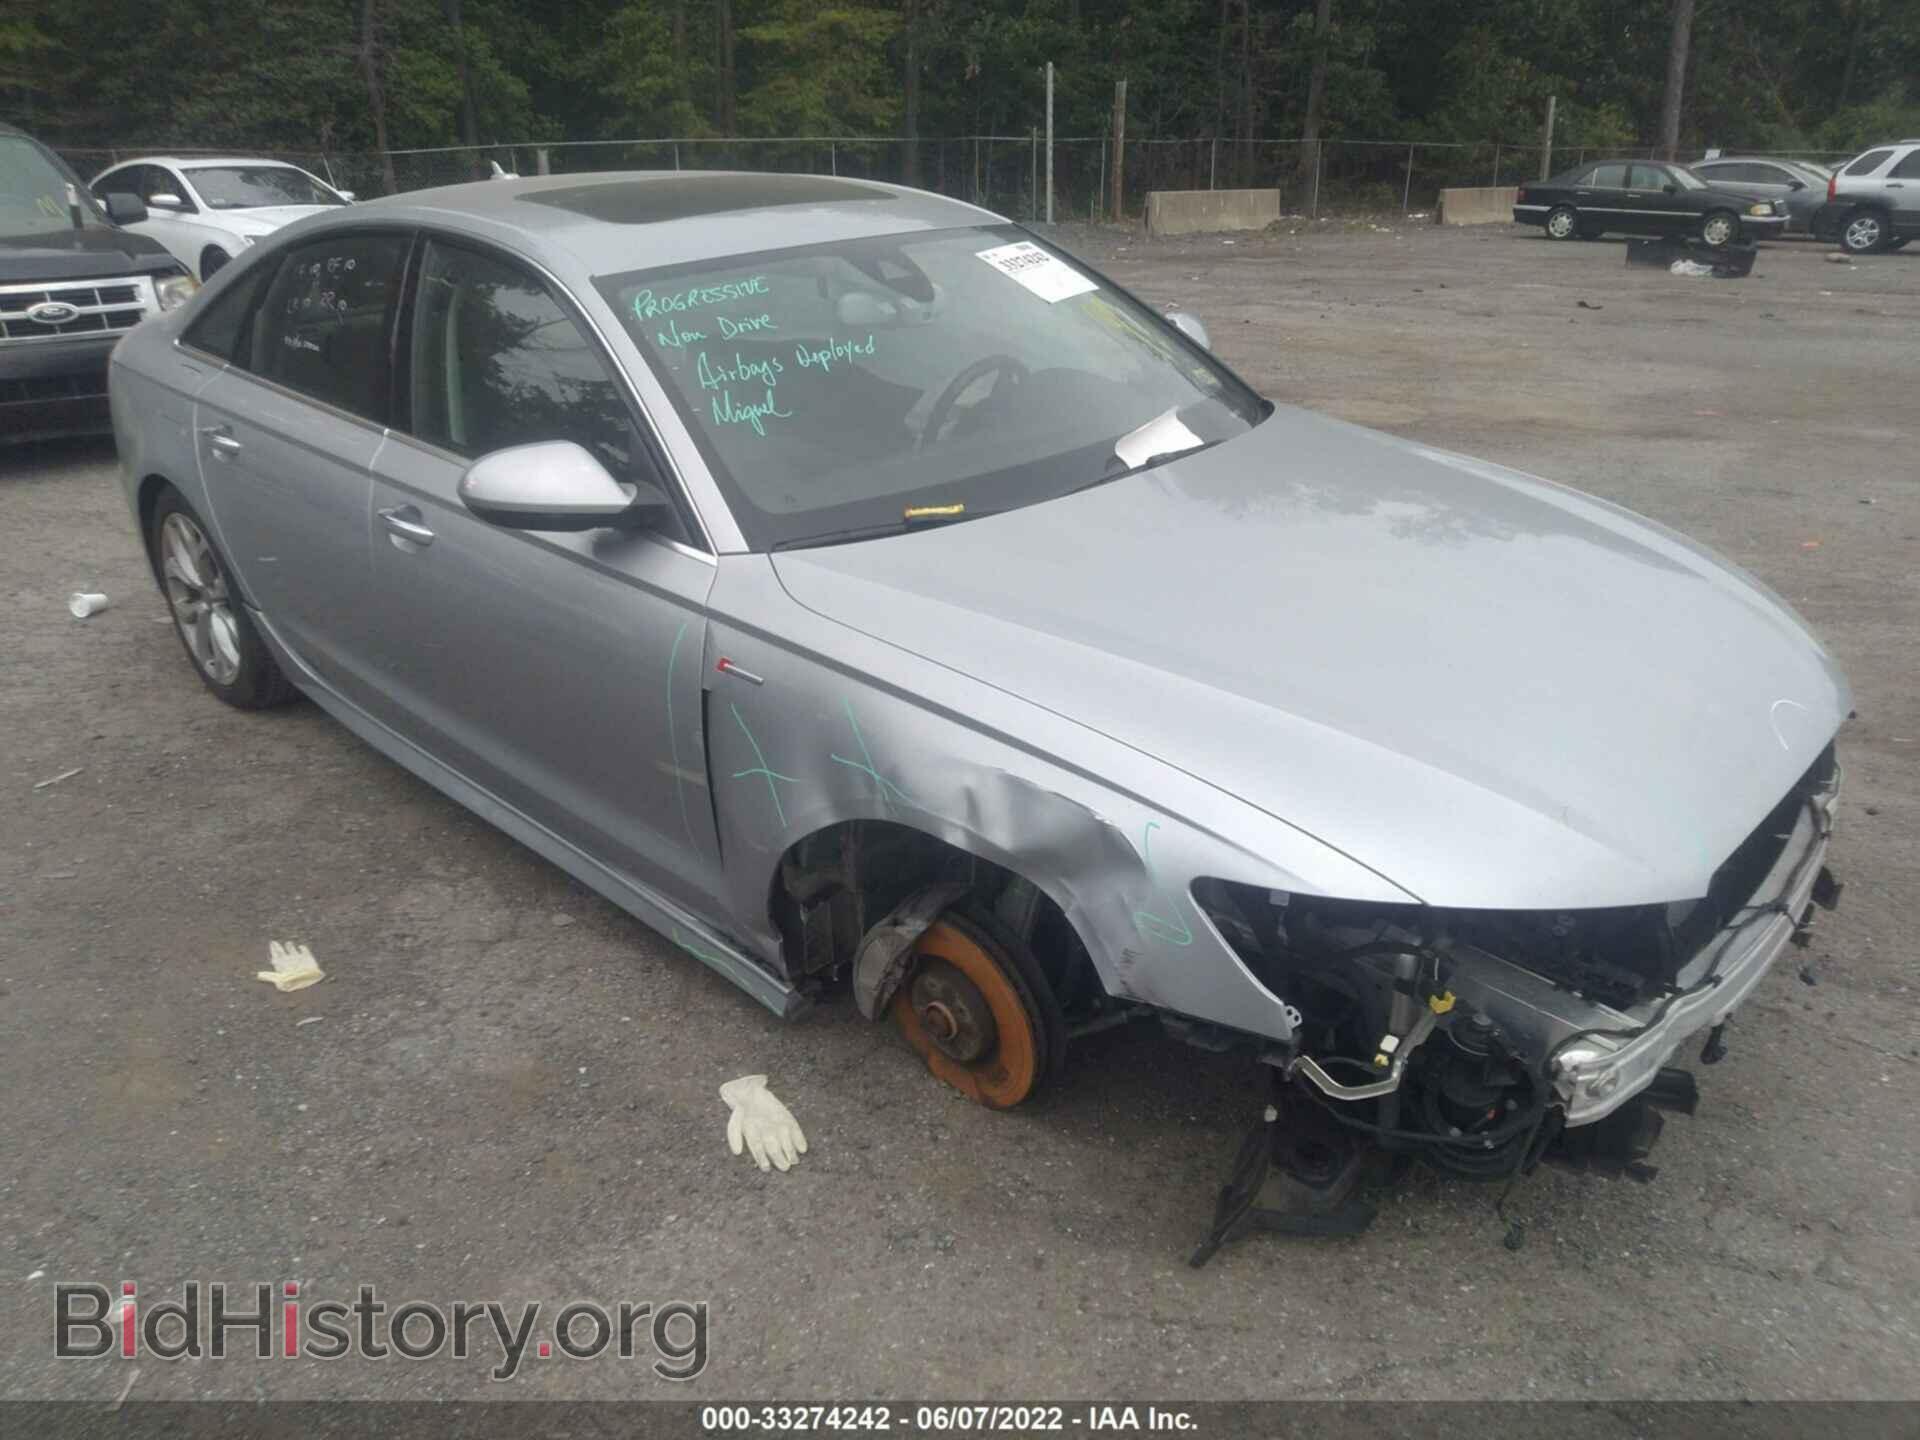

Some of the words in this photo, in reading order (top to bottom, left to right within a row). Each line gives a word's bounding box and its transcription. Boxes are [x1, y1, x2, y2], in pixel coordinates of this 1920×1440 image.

[632, 275, 769, 321] PROGRESSIVE
[717, 313, 779, 341] Drive
[697, 351, 784, 390] Airbags
[795, 334, 876, 373] Deployed
